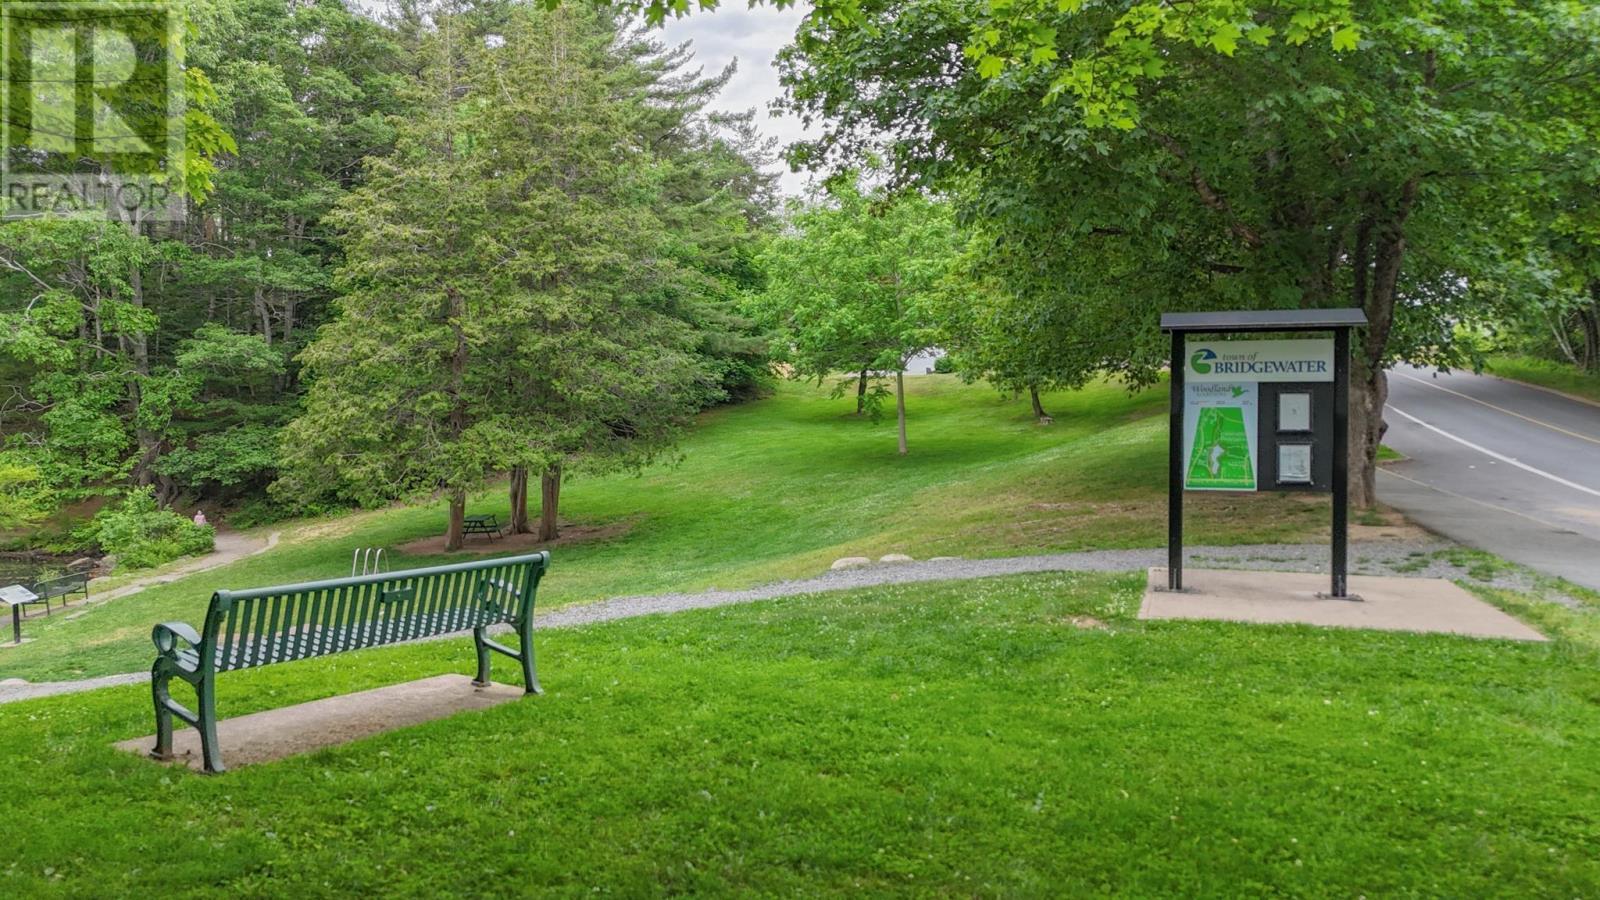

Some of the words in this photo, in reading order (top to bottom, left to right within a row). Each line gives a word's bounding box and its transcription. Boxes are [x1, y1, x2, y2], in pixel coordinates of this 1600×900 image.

[1222, 353, 1245, 361] town
[1247, 352, 1257, 361] of
[1214, 360, 1327, 374] BRIDGEWATER
